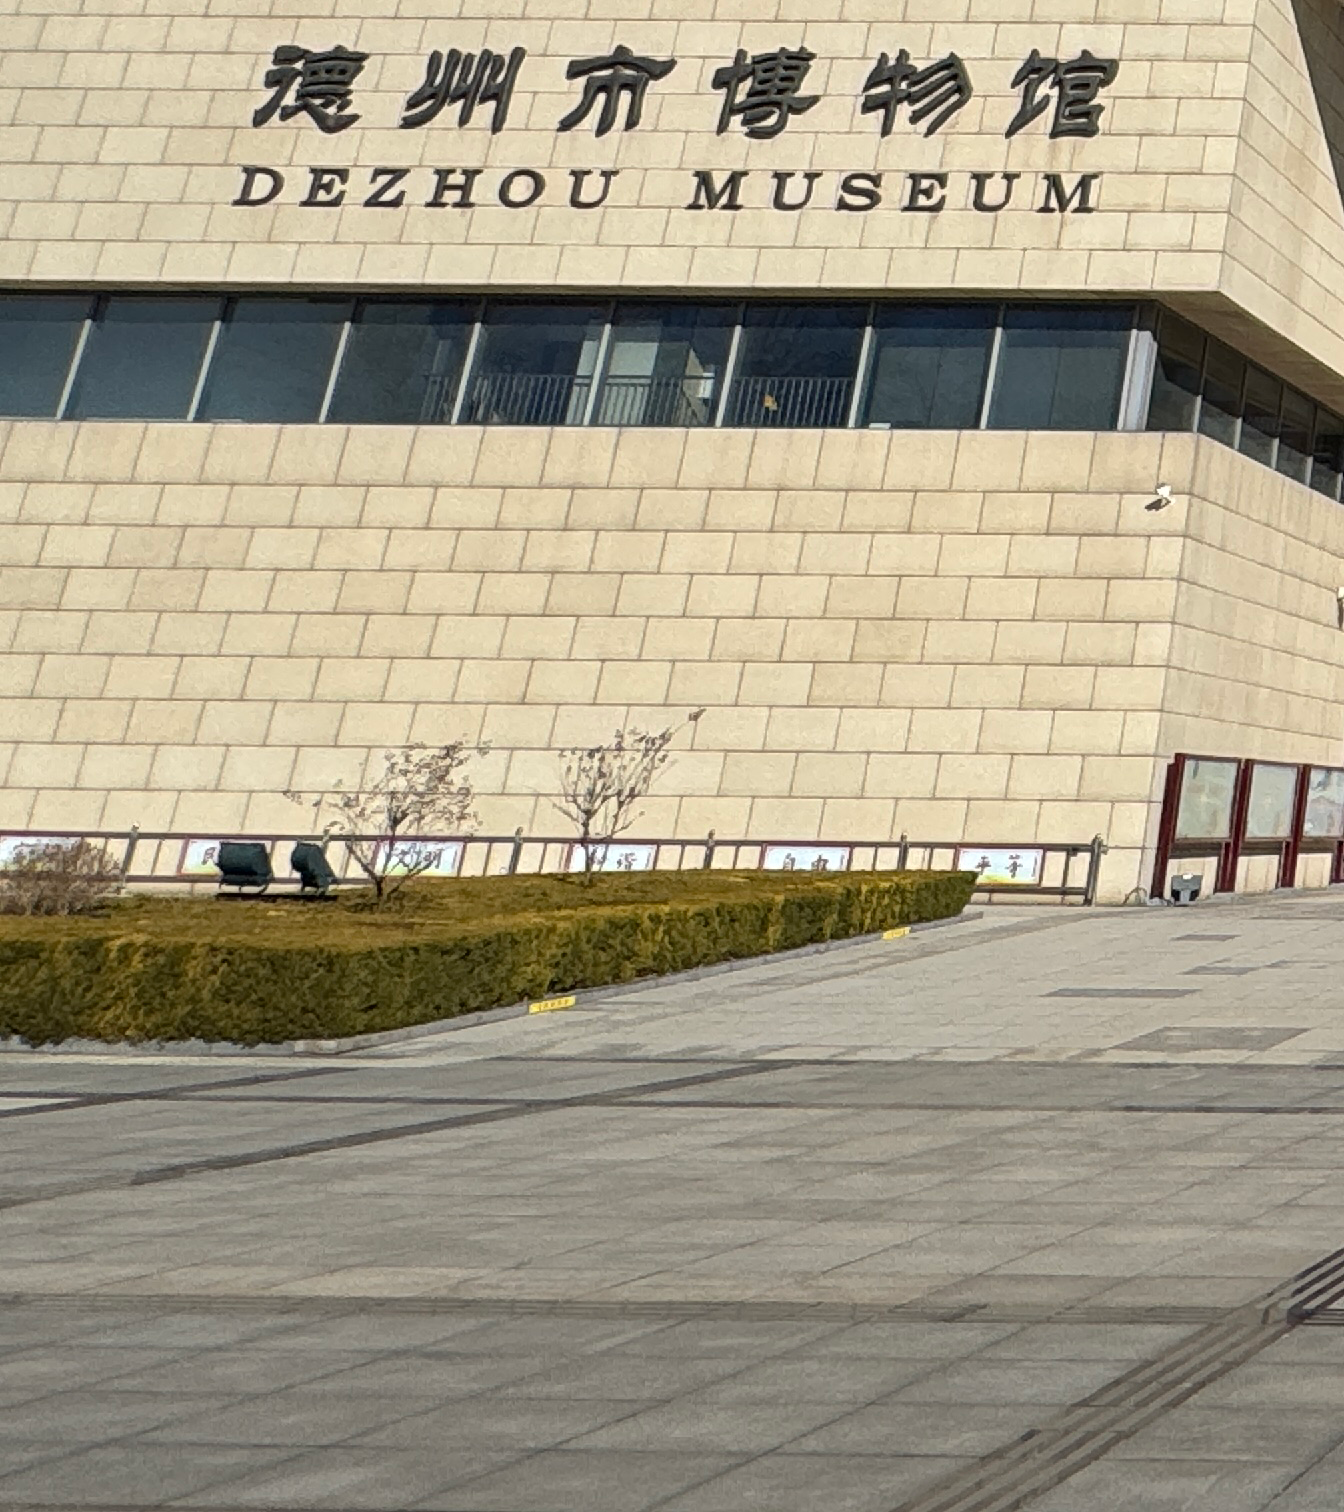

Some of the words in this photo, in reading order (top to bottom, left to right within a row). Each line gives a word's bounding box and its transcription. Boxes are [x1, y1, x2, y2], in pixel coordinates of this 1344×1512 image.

[252, 44, 1119, 139] 德州市博物馆
[233, 167, 620, 209] DEZHOU
[688, 170, 1098, 215] MUSEUM
[975, 855, 1023, 879] 平等
